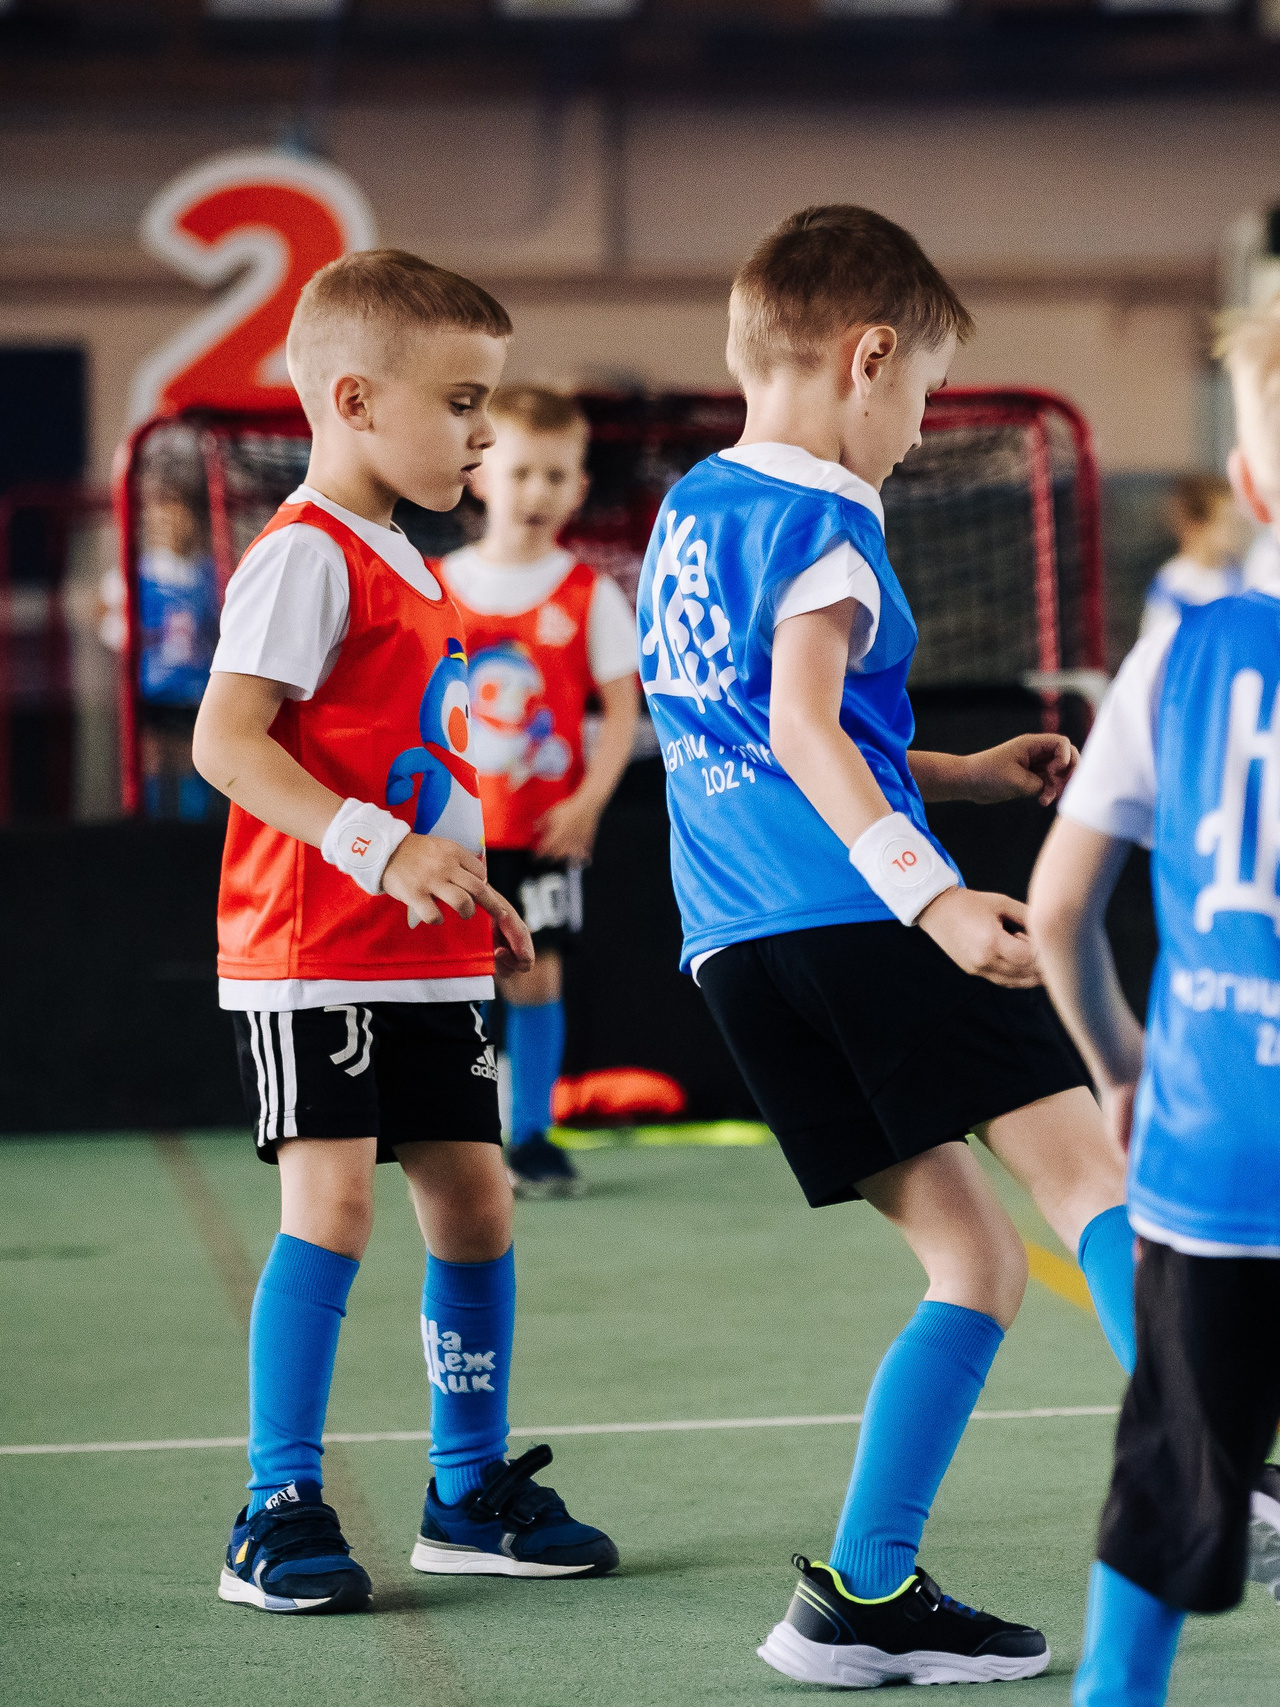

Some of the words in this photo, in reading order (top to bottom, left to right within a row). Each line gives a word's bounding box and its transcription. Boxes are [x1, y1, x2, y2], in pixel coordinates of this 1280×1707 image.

[132, 152, 374, 420] 2
[701, 760, 757, 797] 2024
[350, 836, 373, 857] 13
[892, 850, 917, 873] 10
